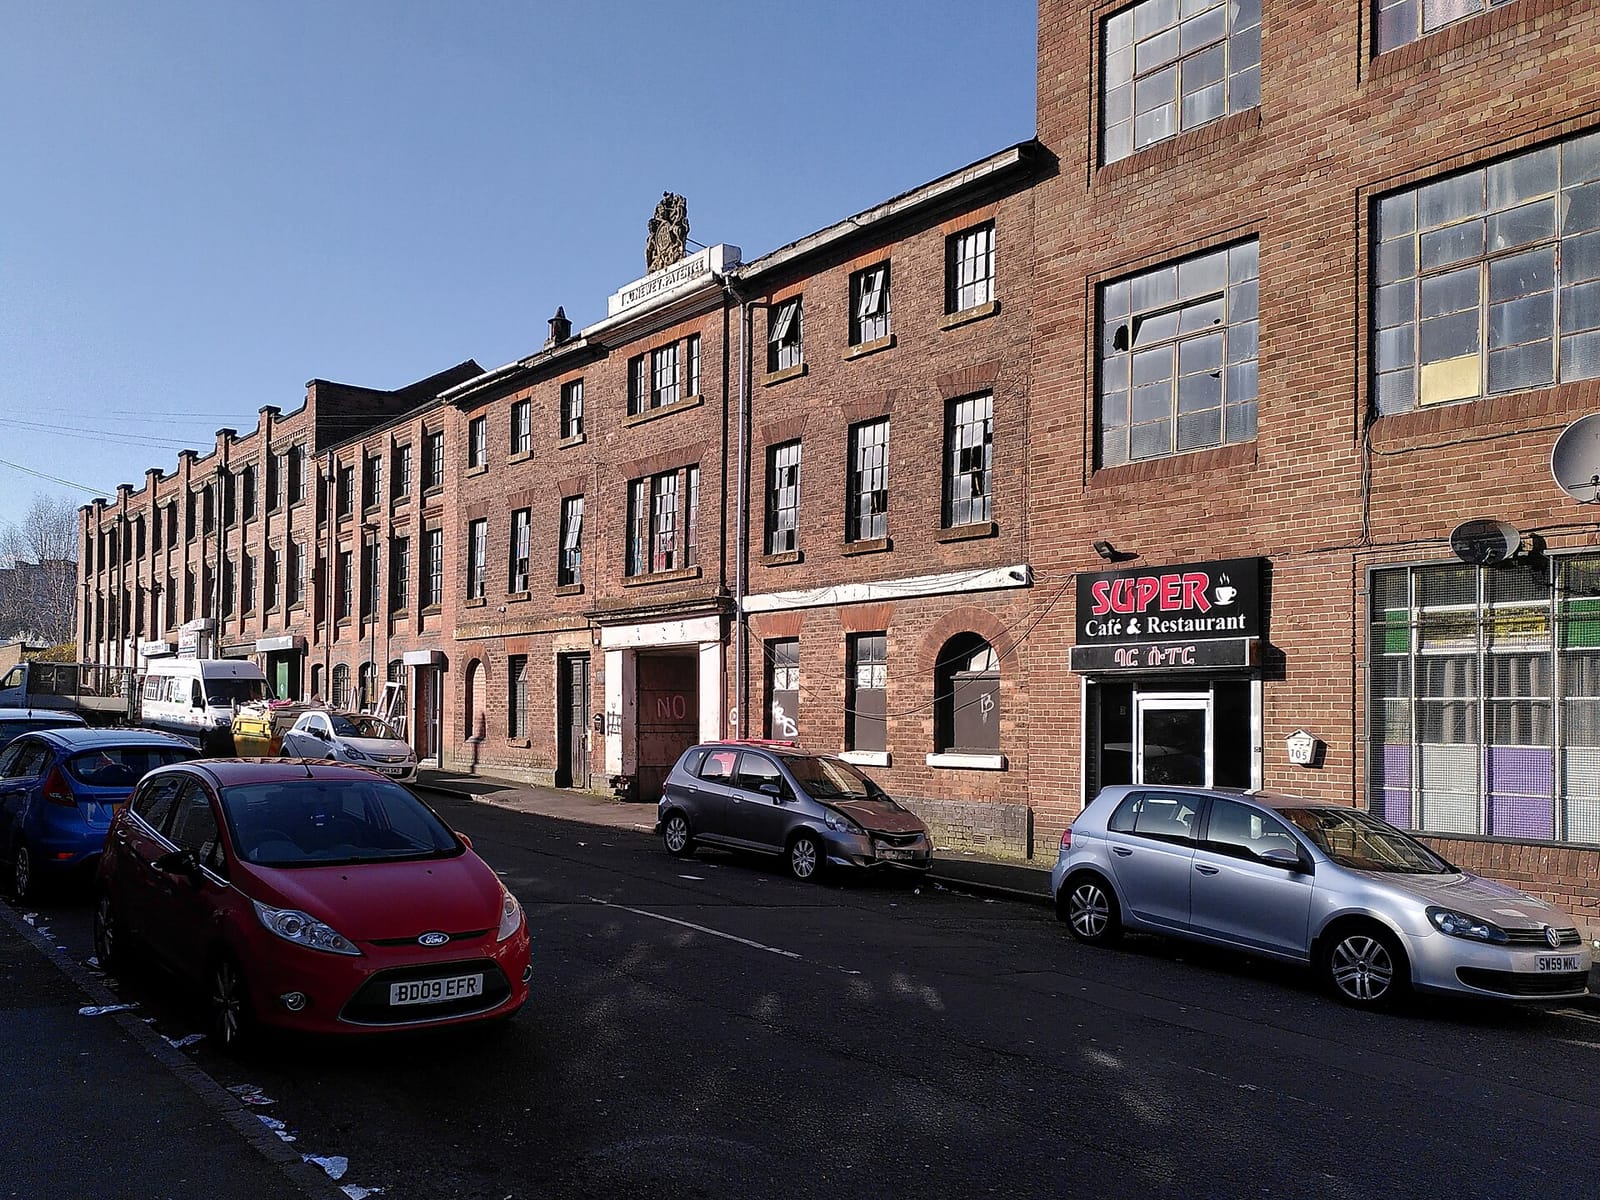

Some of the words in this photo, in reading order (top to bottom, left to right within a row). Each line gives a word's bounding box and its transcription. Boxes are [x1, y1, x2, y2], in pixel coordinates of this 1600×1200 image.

[1091, 572, 1212, 616] SUPER
[1085, 618, 1122, 637] Café
[1126, 617, 1142, 635] &
[1147, 613, 1246, 634] Restaurant
[657, 695, 686, 719] NO
[1291, 749, 1307, 761] 105
[425, 934, 443, 944] Ford
[1540, 957, 1562, 971] SW59
[398, 981, 442, 1002] BD09
[446, 977, 476, 997] EFR
